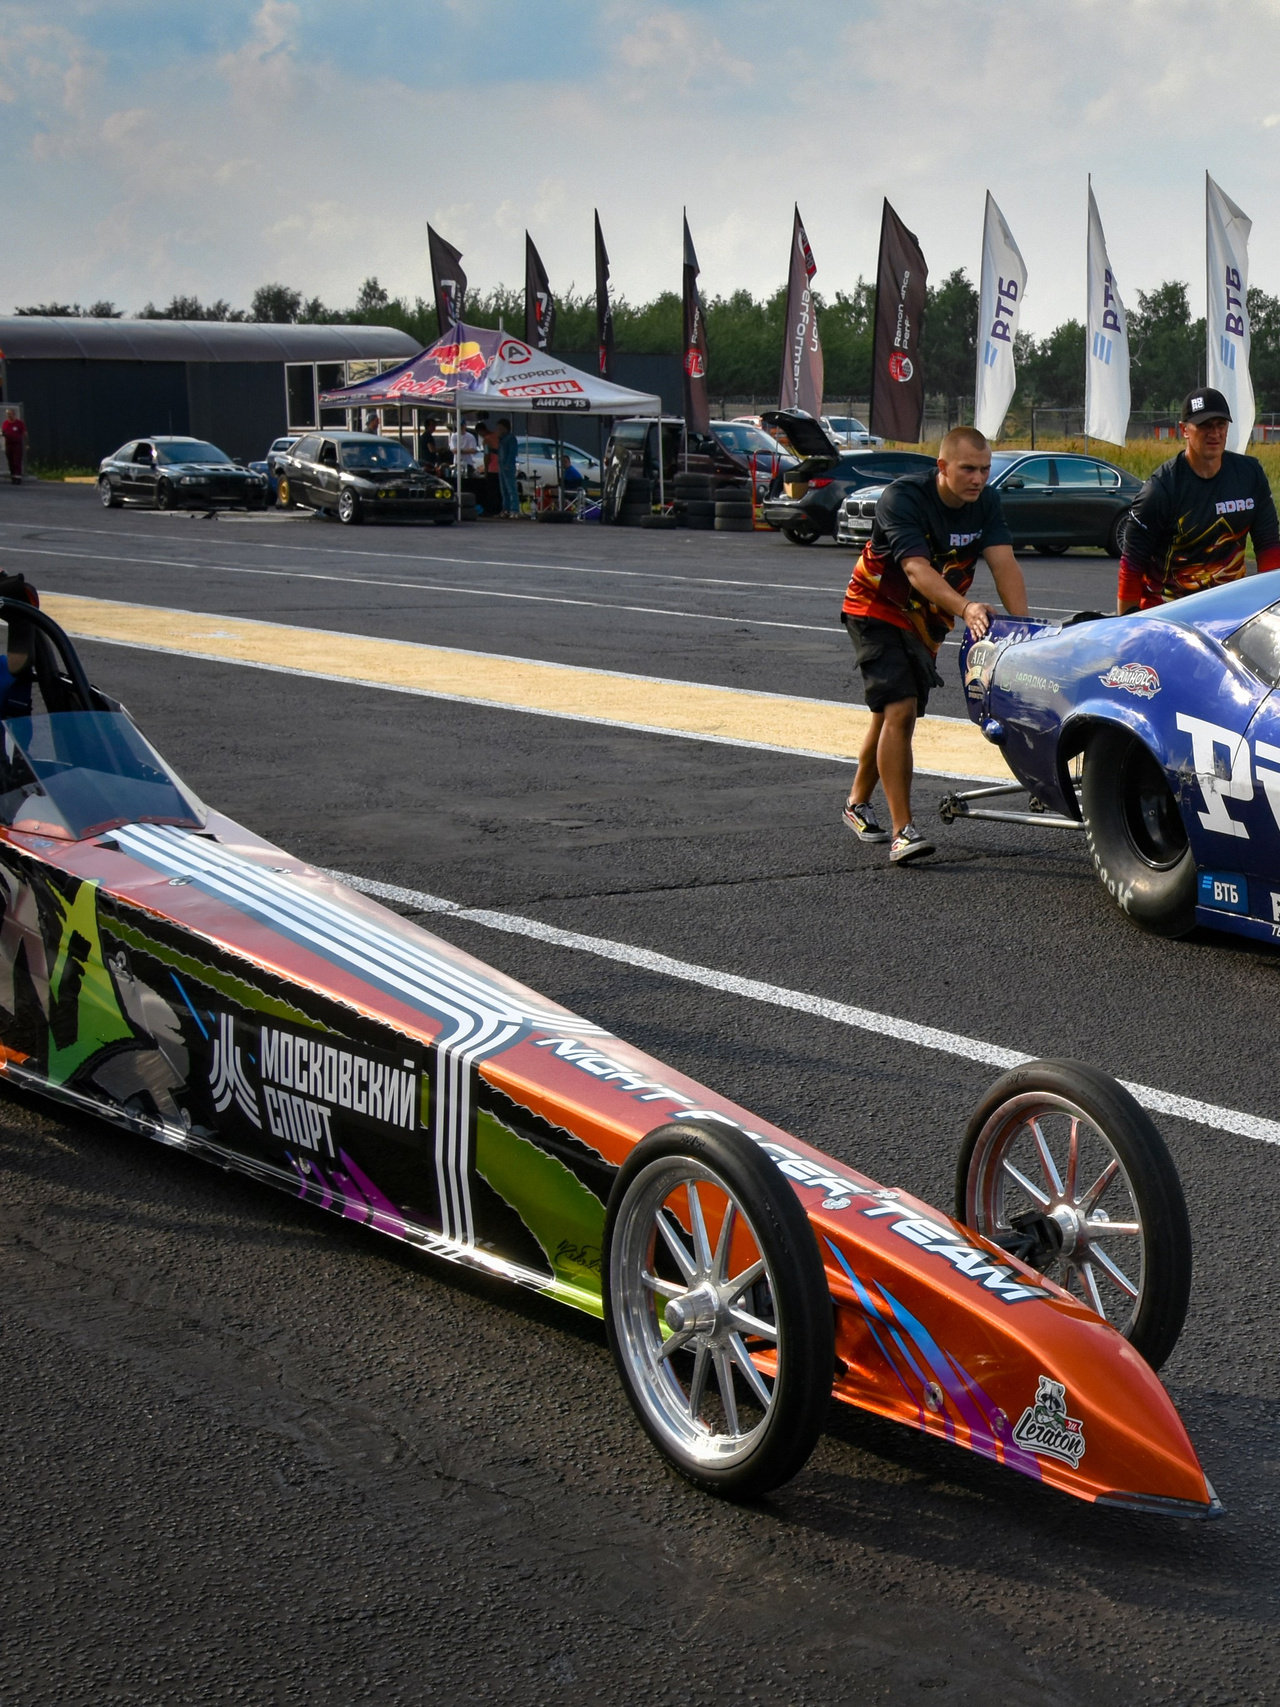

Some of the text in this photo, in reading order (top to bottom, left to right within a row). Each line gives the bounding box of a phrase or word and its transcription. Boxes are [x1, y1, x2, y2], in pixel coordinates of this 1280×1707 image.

[990, 276, 1018, 342] ВТБ
[1225, 265, 1244, 337] ВТБ
[506, 382, 579, 396] MOTUL
[536, 399, 586, 407] АНГАР 13
[1215, 498, 1255, 514] RDRC
[1213, 881, 1239, 903] ВТБ
[261, 1025, 416, 1131] МОСКОВСКИЙ
[263, 1084, 335, 1158] СПОРТ
[534, 1037, 1050, 1301] NIGHT CER TEAM
[1016, 1411, 1081, 1454] Leraton
